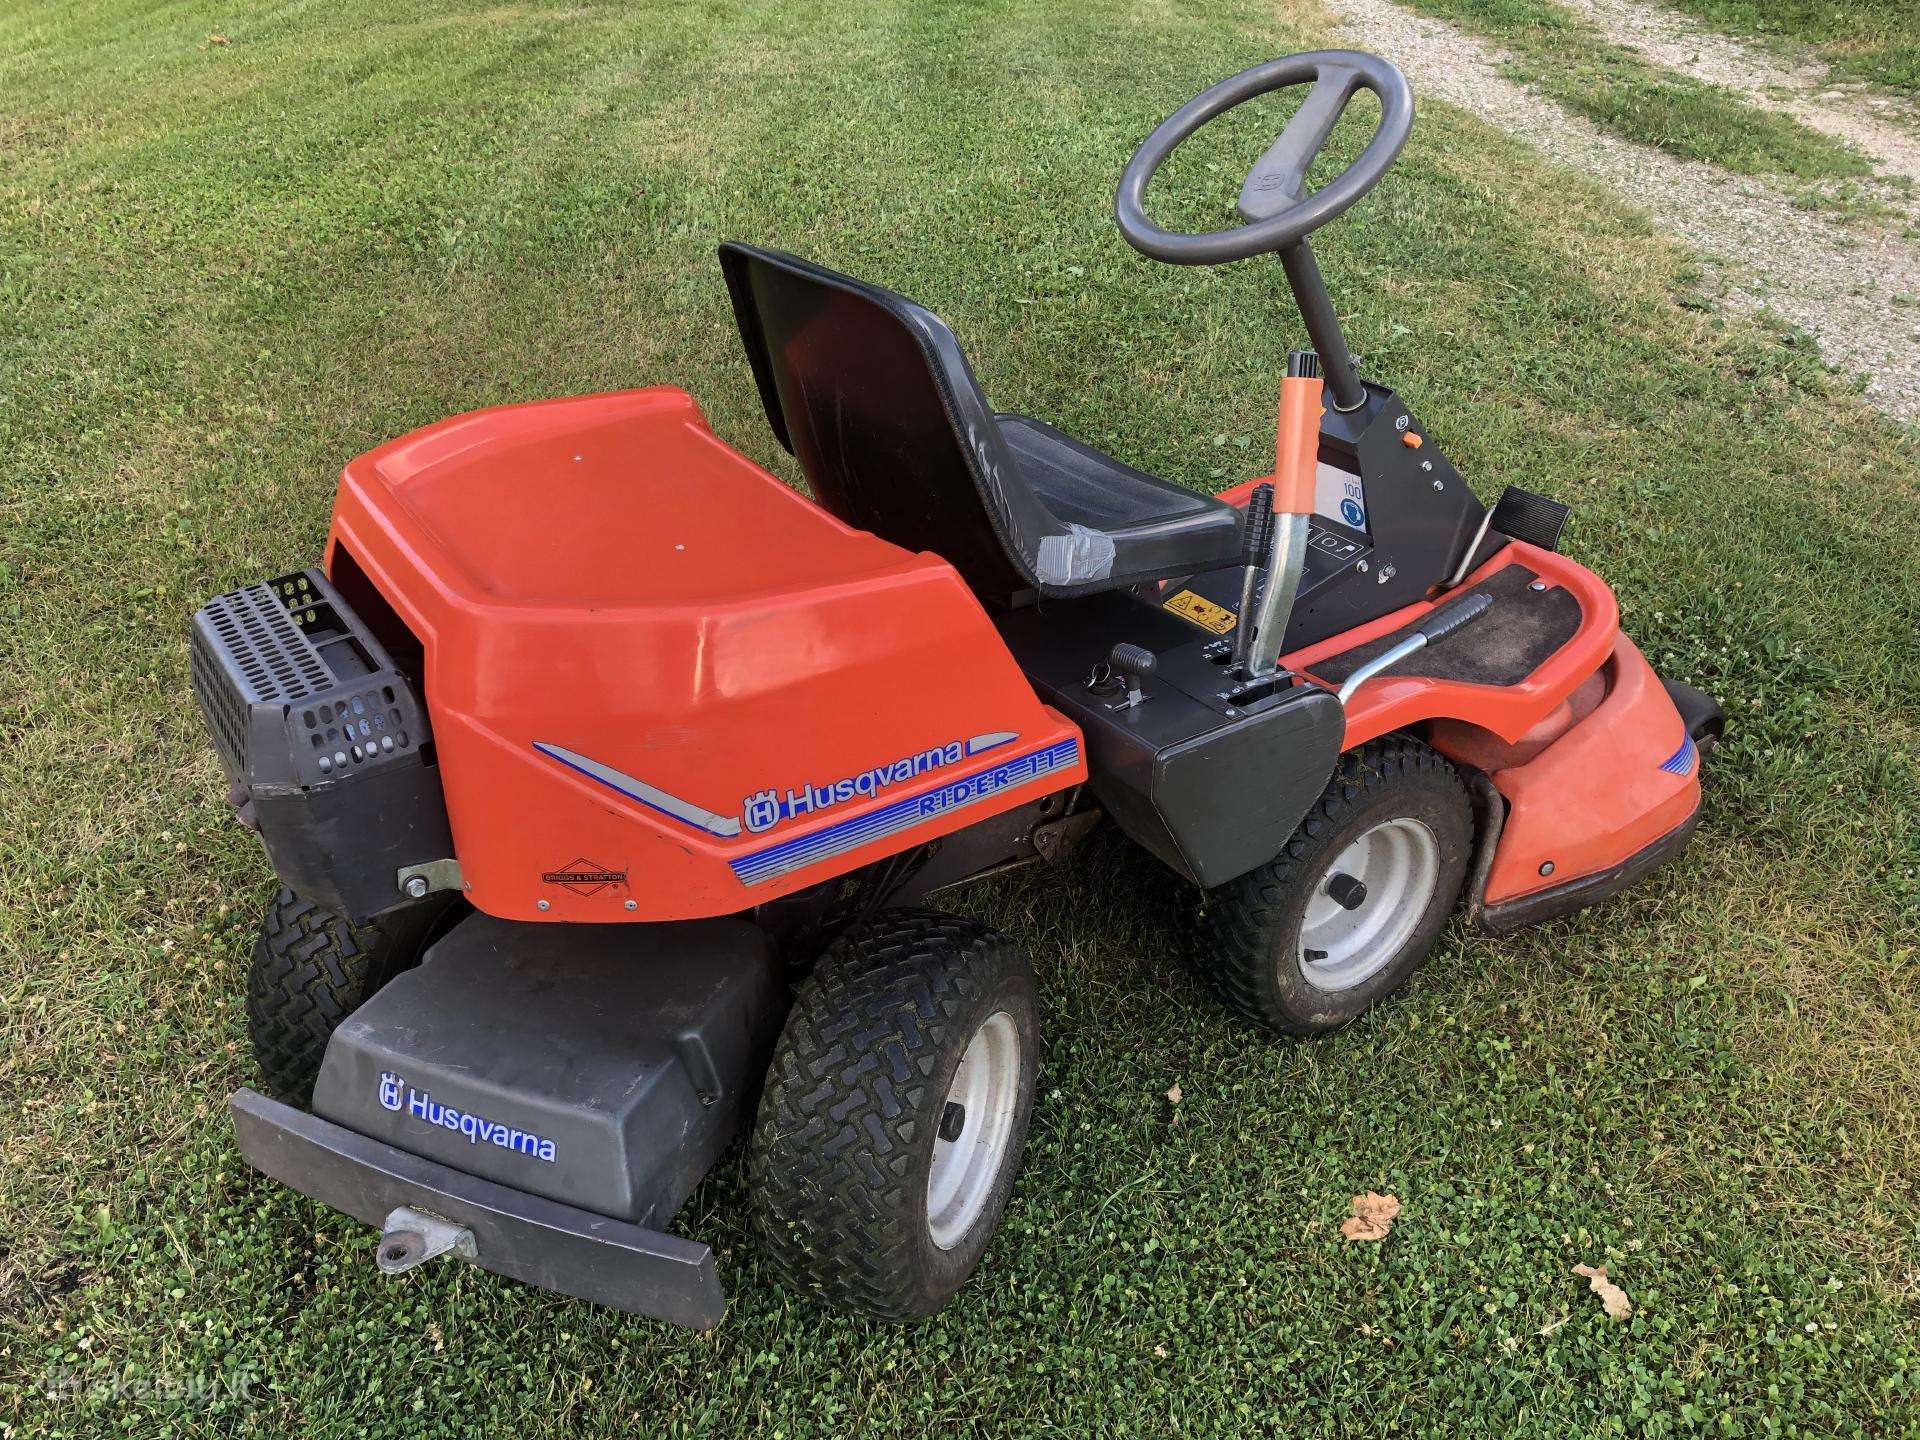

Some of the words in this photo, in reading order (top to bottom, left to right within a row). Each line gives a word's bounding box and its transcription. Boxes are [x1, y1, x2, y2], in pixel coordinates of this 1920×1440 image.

[1344, 482, 1361, 499] 100
[786, 740, 963, 820] Husqvarna
[919, 768, 1009, 816] RIDER
[1027, 750, 1056, 775] 11
[545, 873, 575, 881] BRIGGS
[583, 873, 623, 881] STRATTON
[409, 1087, 557, 1163] Husqvarna
